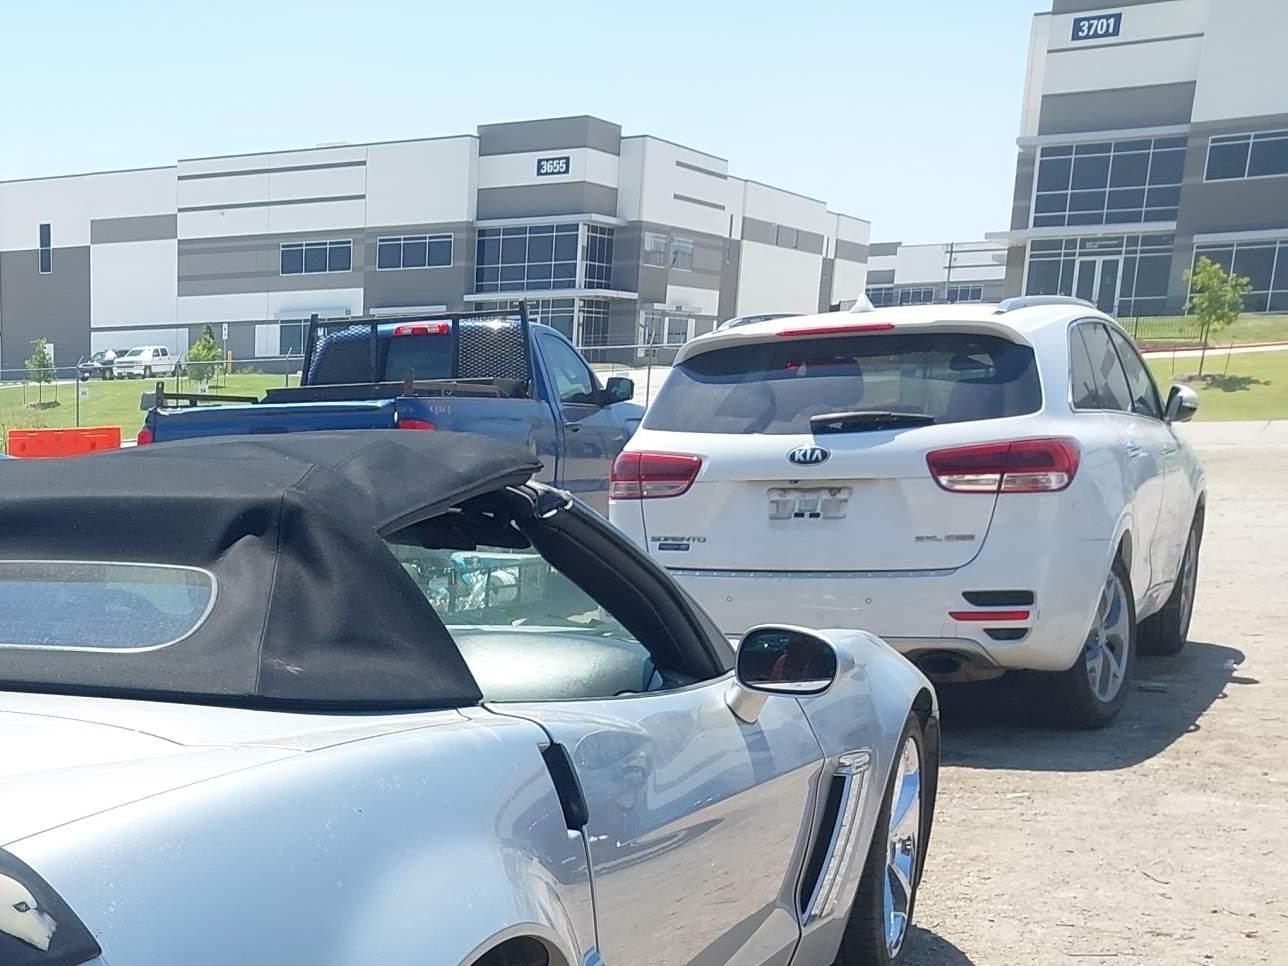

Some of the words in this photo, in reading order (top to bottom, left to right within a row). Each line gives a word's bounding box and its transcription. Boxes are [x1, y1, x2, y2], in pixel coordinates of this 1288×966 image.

[1078, 17, 1115, 37] 3701
[540, 159, 566, 173] 3655
[794, 448, 823, 462] KIA
[650, 535, 707, 543] SORENTO
